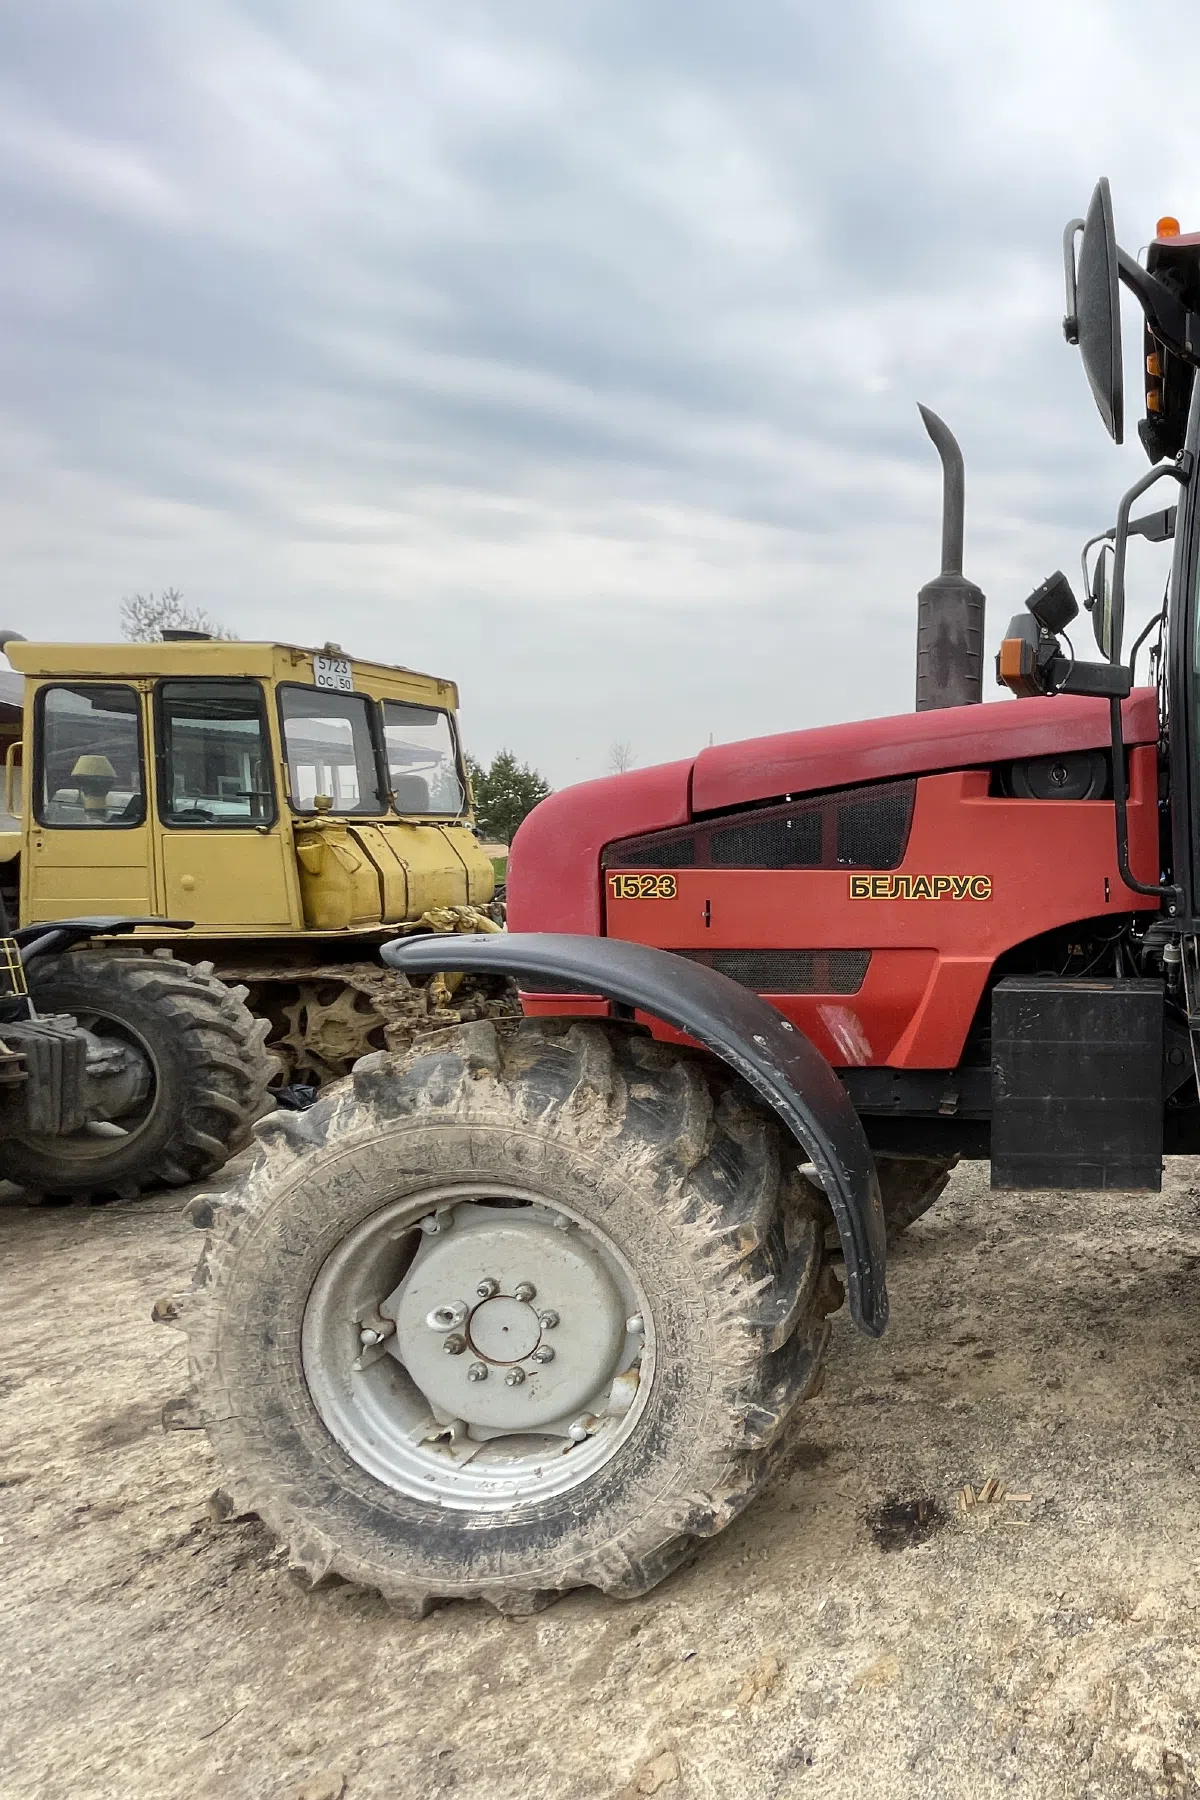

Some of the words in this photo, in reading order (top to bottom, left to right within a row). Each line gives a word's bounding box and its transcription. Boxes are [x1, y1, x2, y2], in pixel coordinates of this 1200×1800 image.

[318, 656, 348, 674] 5723
[339, 678, 351, 690] 50
[608, 874, 677, 899] 1523
[849, 874, 992, 901] БЕЛАРУС
